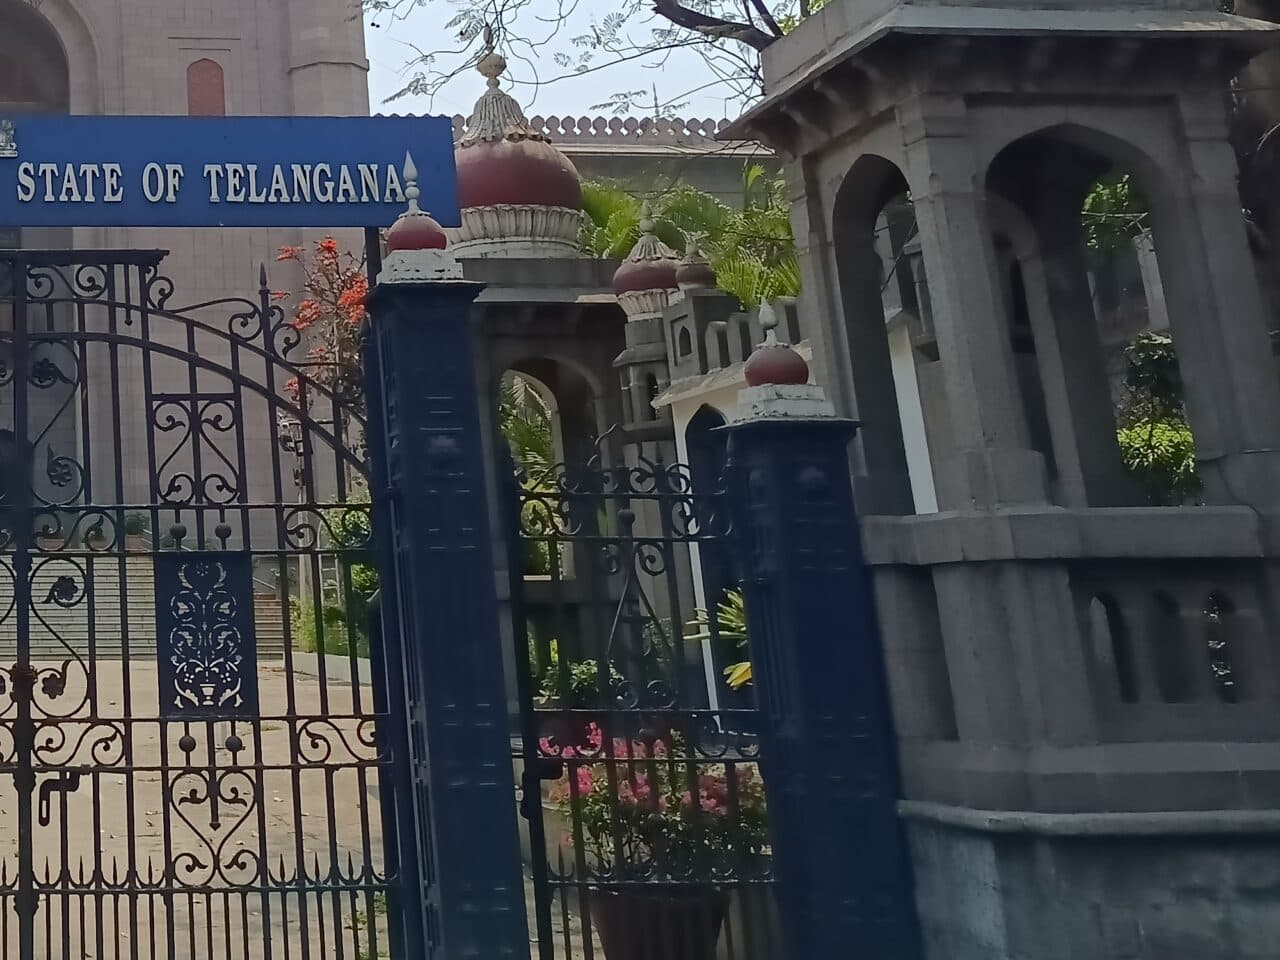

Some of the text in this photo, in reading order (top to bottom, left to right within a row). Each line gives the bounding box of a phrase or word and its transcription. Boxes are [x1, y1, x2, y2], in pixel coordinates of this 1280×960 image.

[17, 161, 123, 203] STATE
[142, 161, 185, 203] OF
[203, 162, 406, 203] TELANGANA
